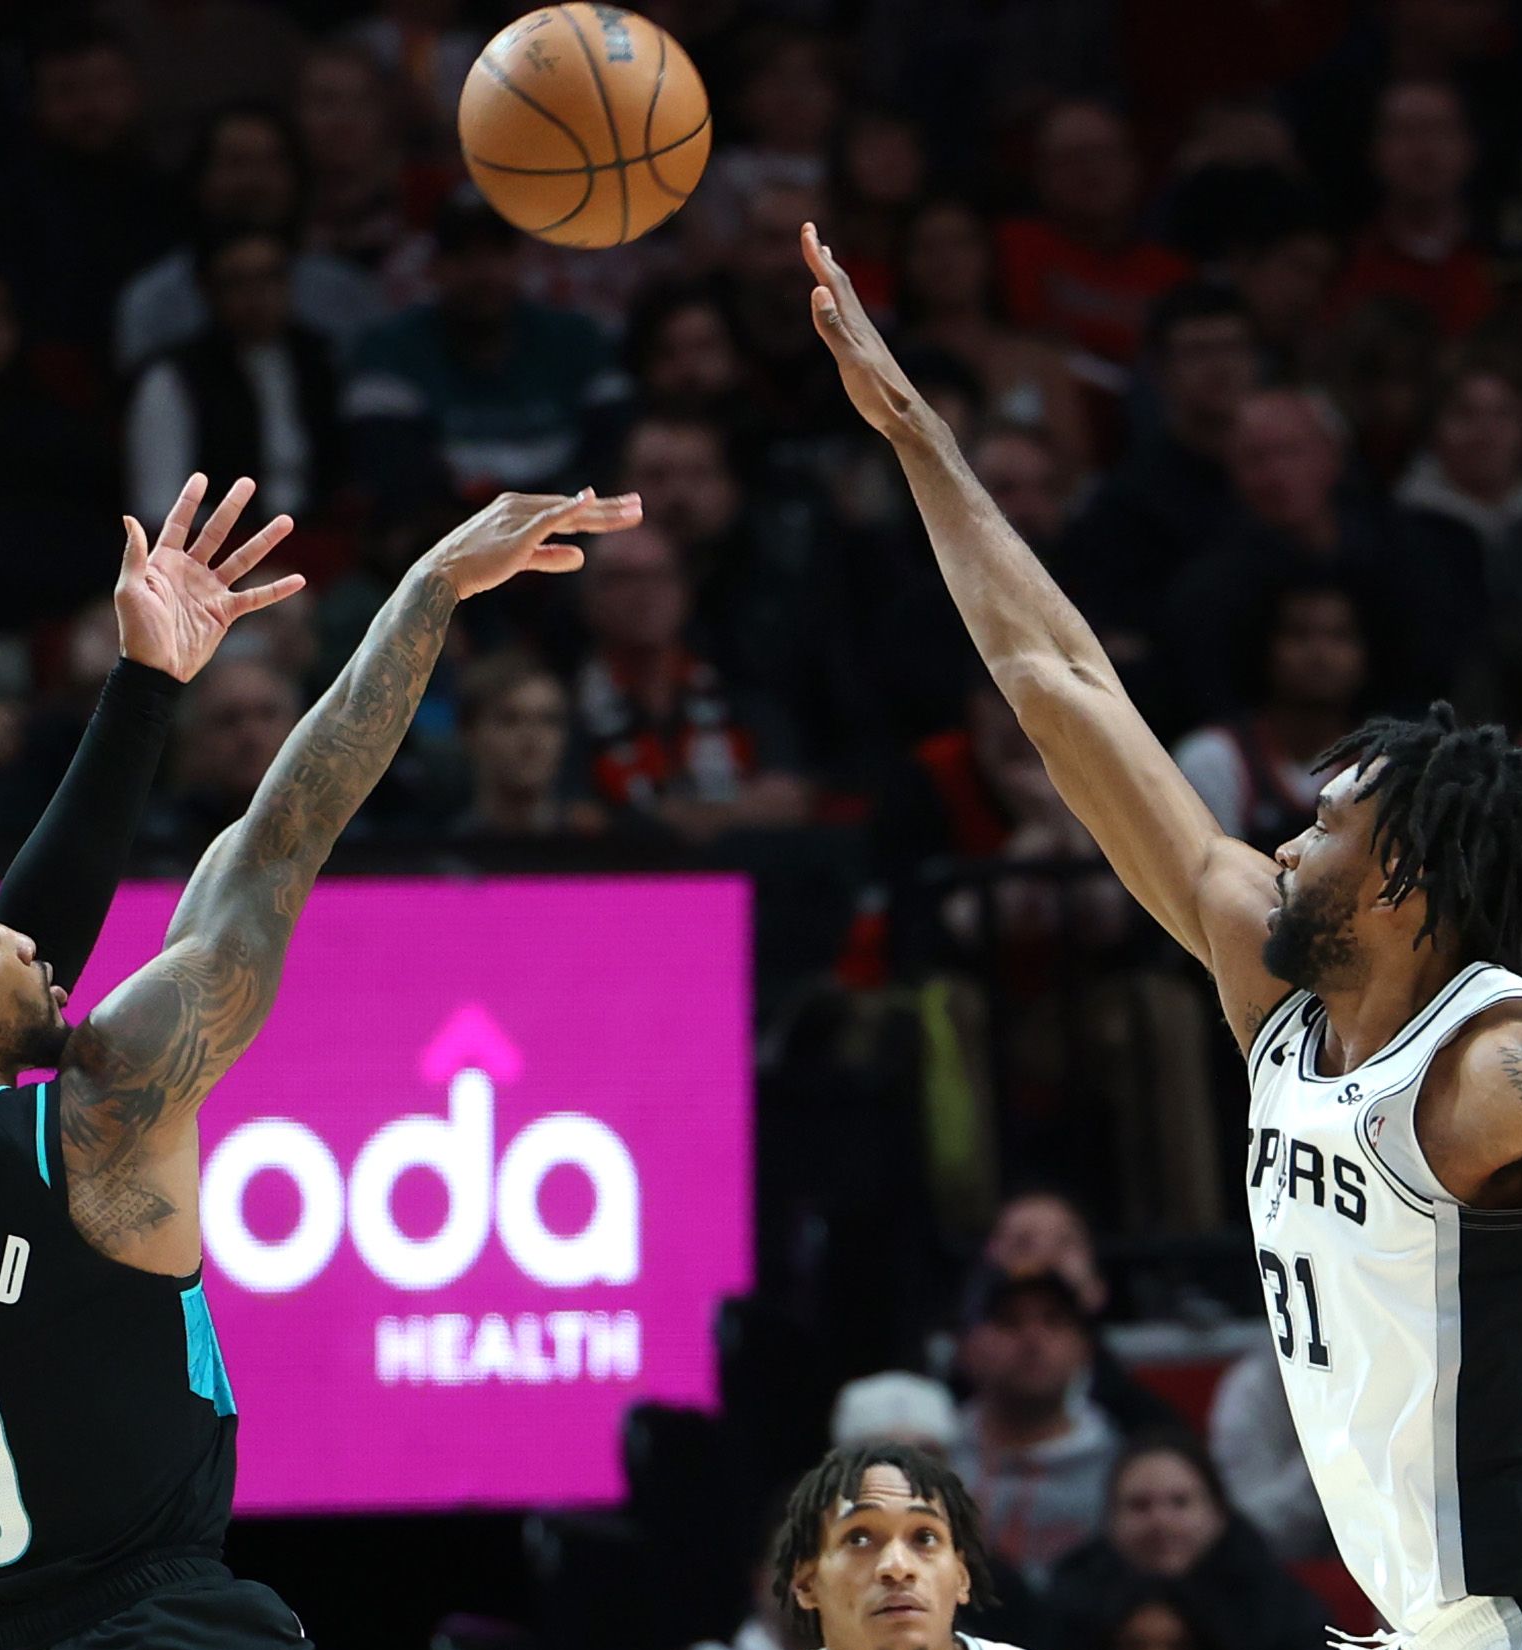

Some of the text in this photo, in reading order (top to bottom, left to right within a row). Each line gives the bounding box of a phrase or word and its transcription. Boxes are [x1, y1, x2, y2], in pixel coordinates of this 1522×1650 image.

[200, 1067, 642, 1294] oda
[375, 1310, 642, 1386] HEALTH
[1257, 1247, 1333, 1372] 31
